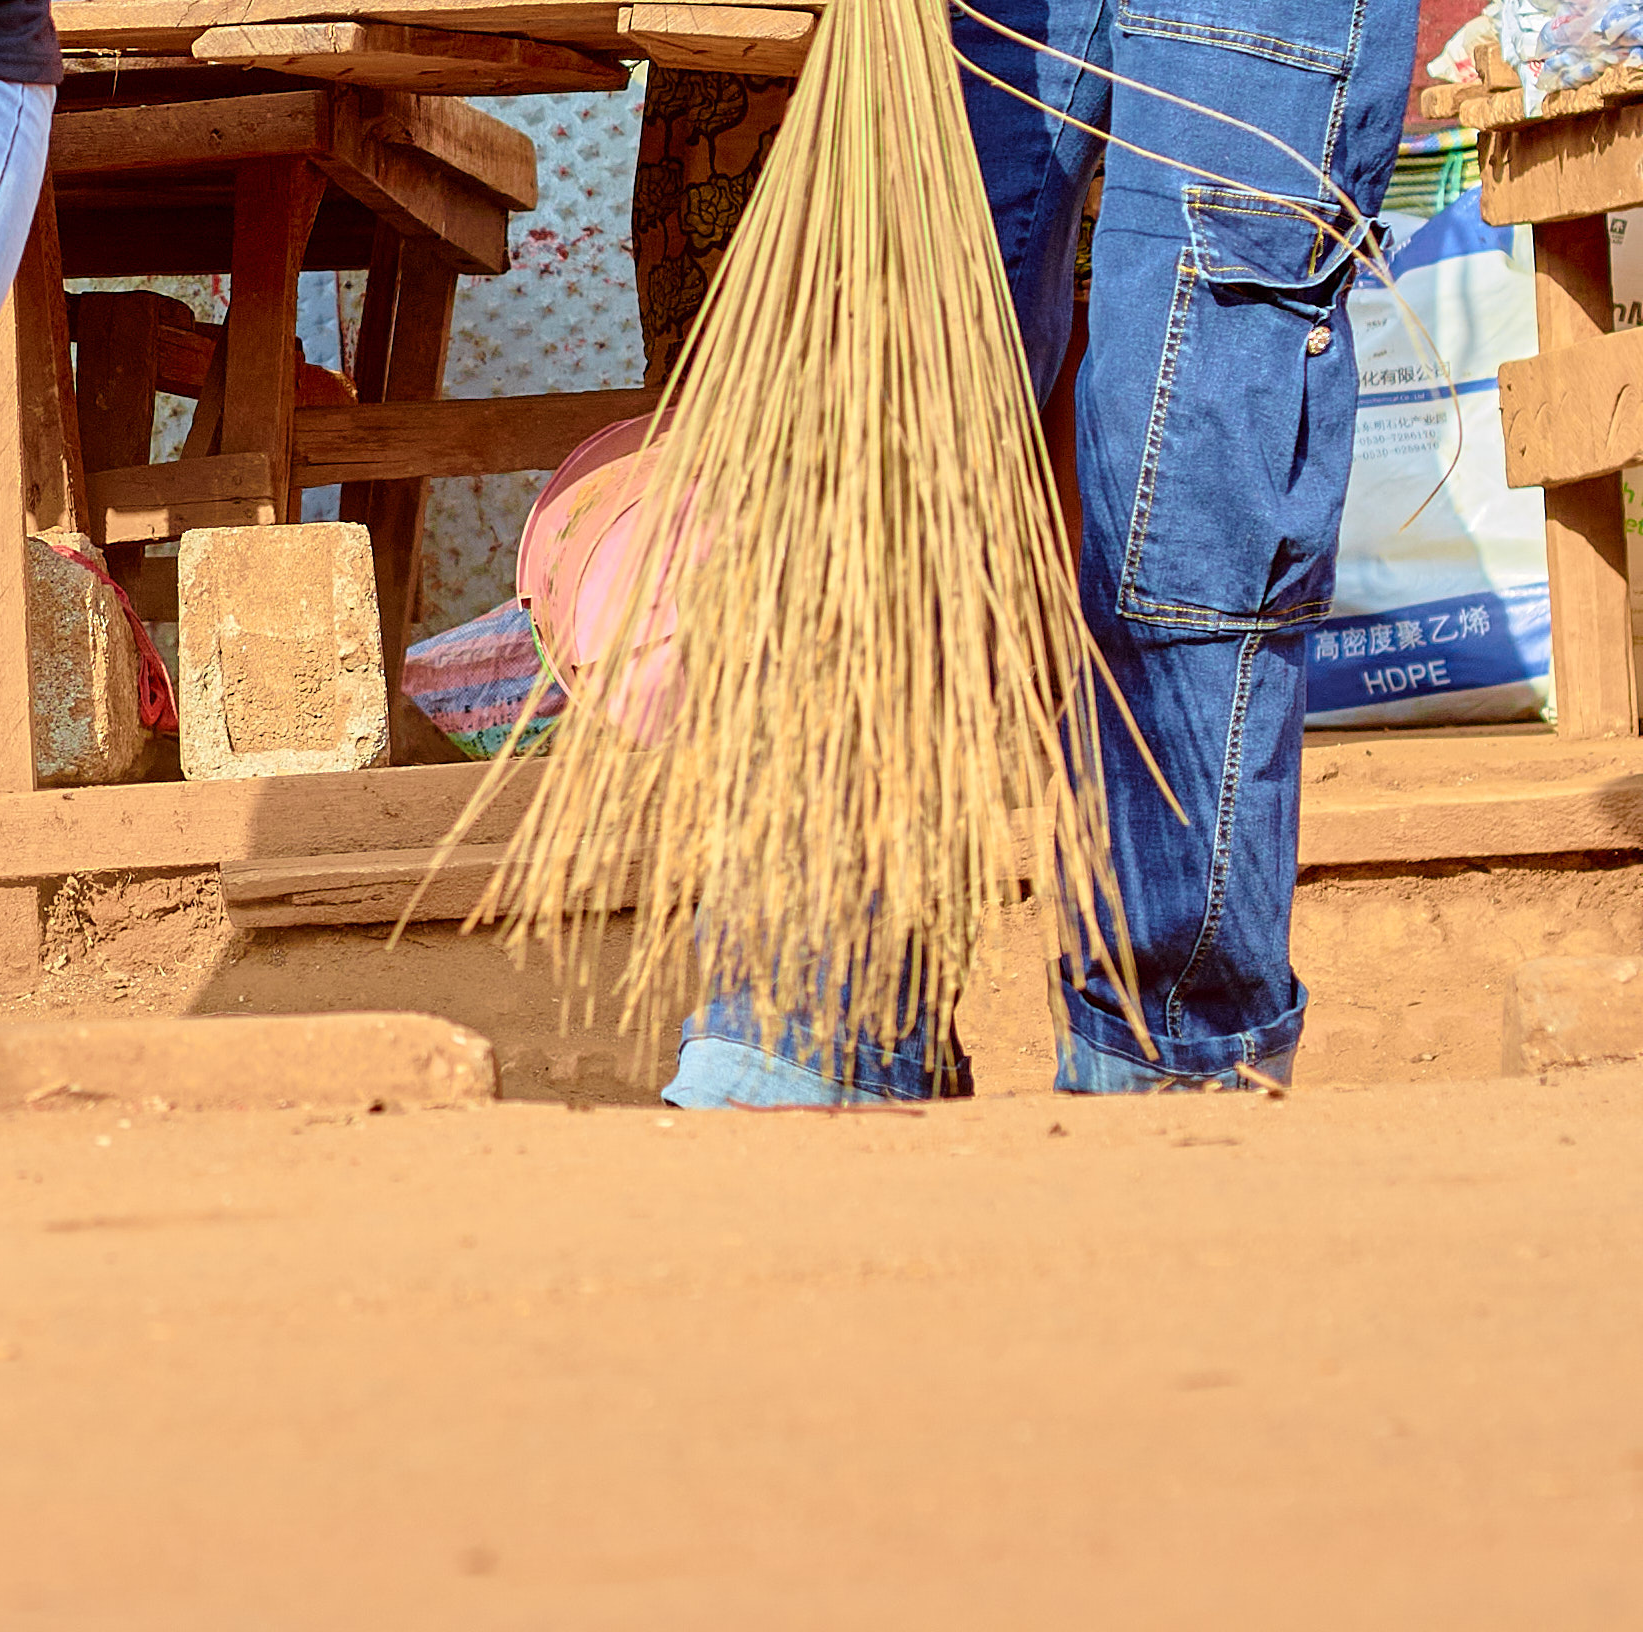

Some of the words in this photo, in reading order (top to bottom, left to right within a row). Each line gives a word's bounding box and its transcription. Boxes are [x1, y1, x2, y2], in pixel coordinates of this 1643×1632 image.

[1315, 604, 1491, 661] 高密度聚乙烯
[1363, 659, 1451, 696] HDPE
